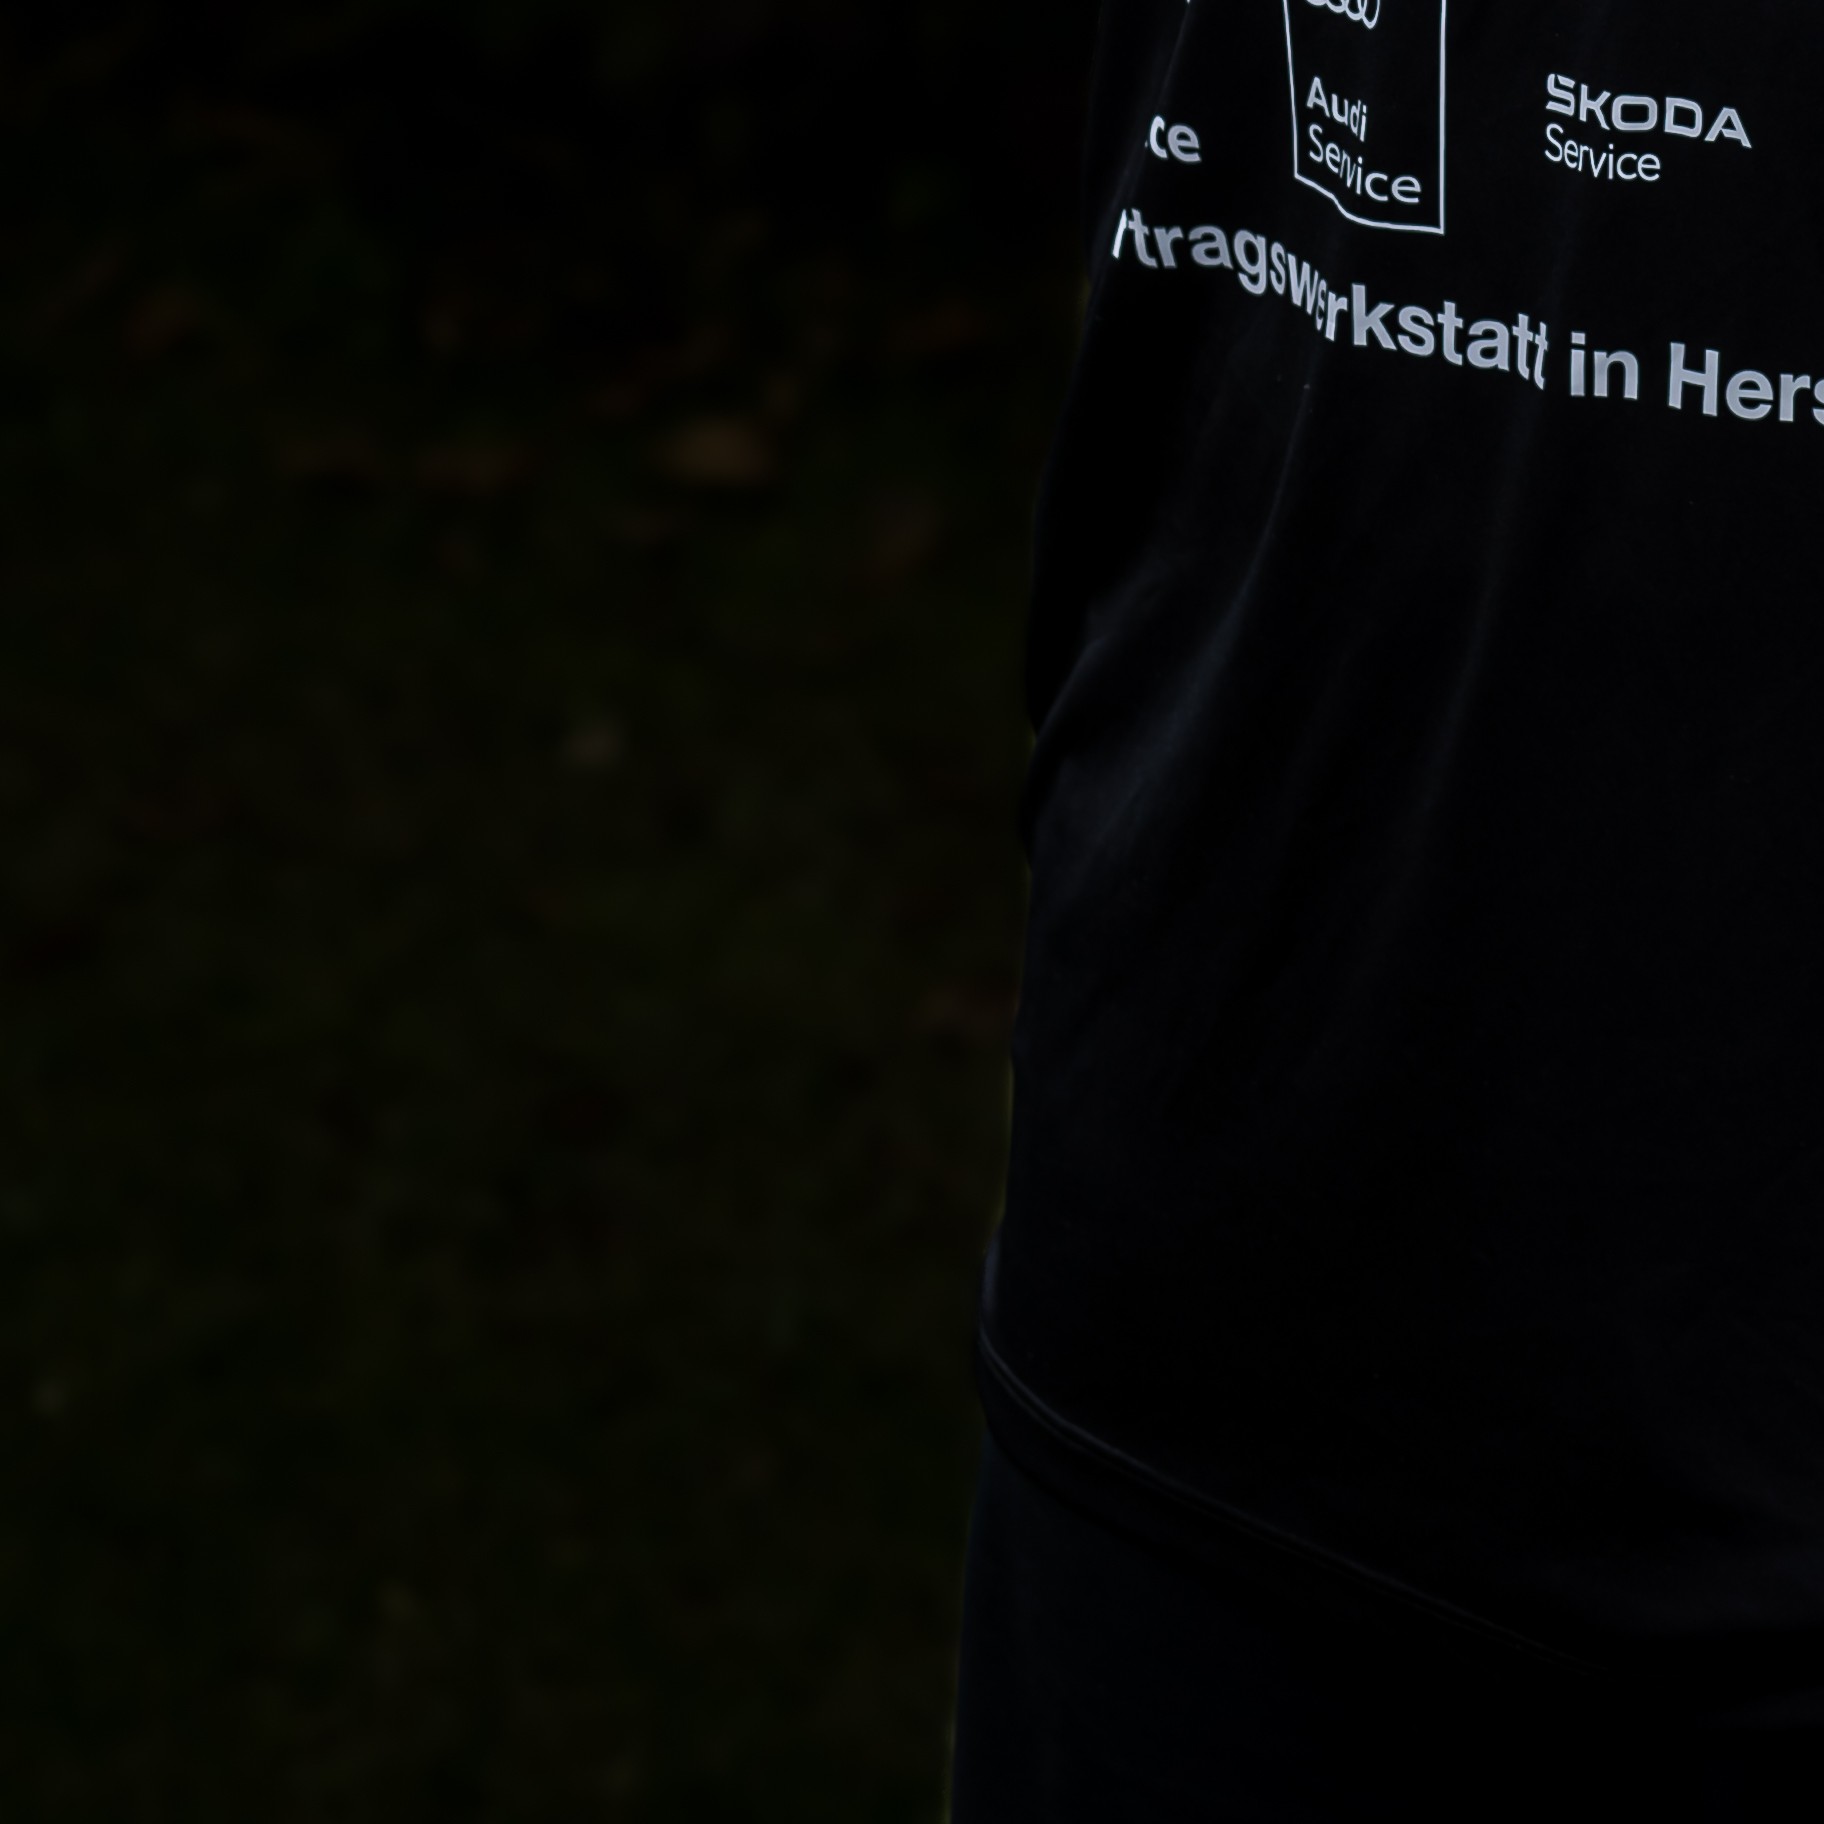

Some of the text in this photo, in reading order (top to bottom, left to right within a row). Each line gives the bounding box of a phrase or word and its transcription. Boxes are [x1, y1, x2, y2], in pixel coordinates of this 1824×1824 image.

[1144, 113, 1203, 165] ce
[1305, 75, 1368, 144] Audi
[1307, 122, 1423, 205] Service
[1543, 121, 1662, 183] Service
[1569, 330, 1640, 402] in
